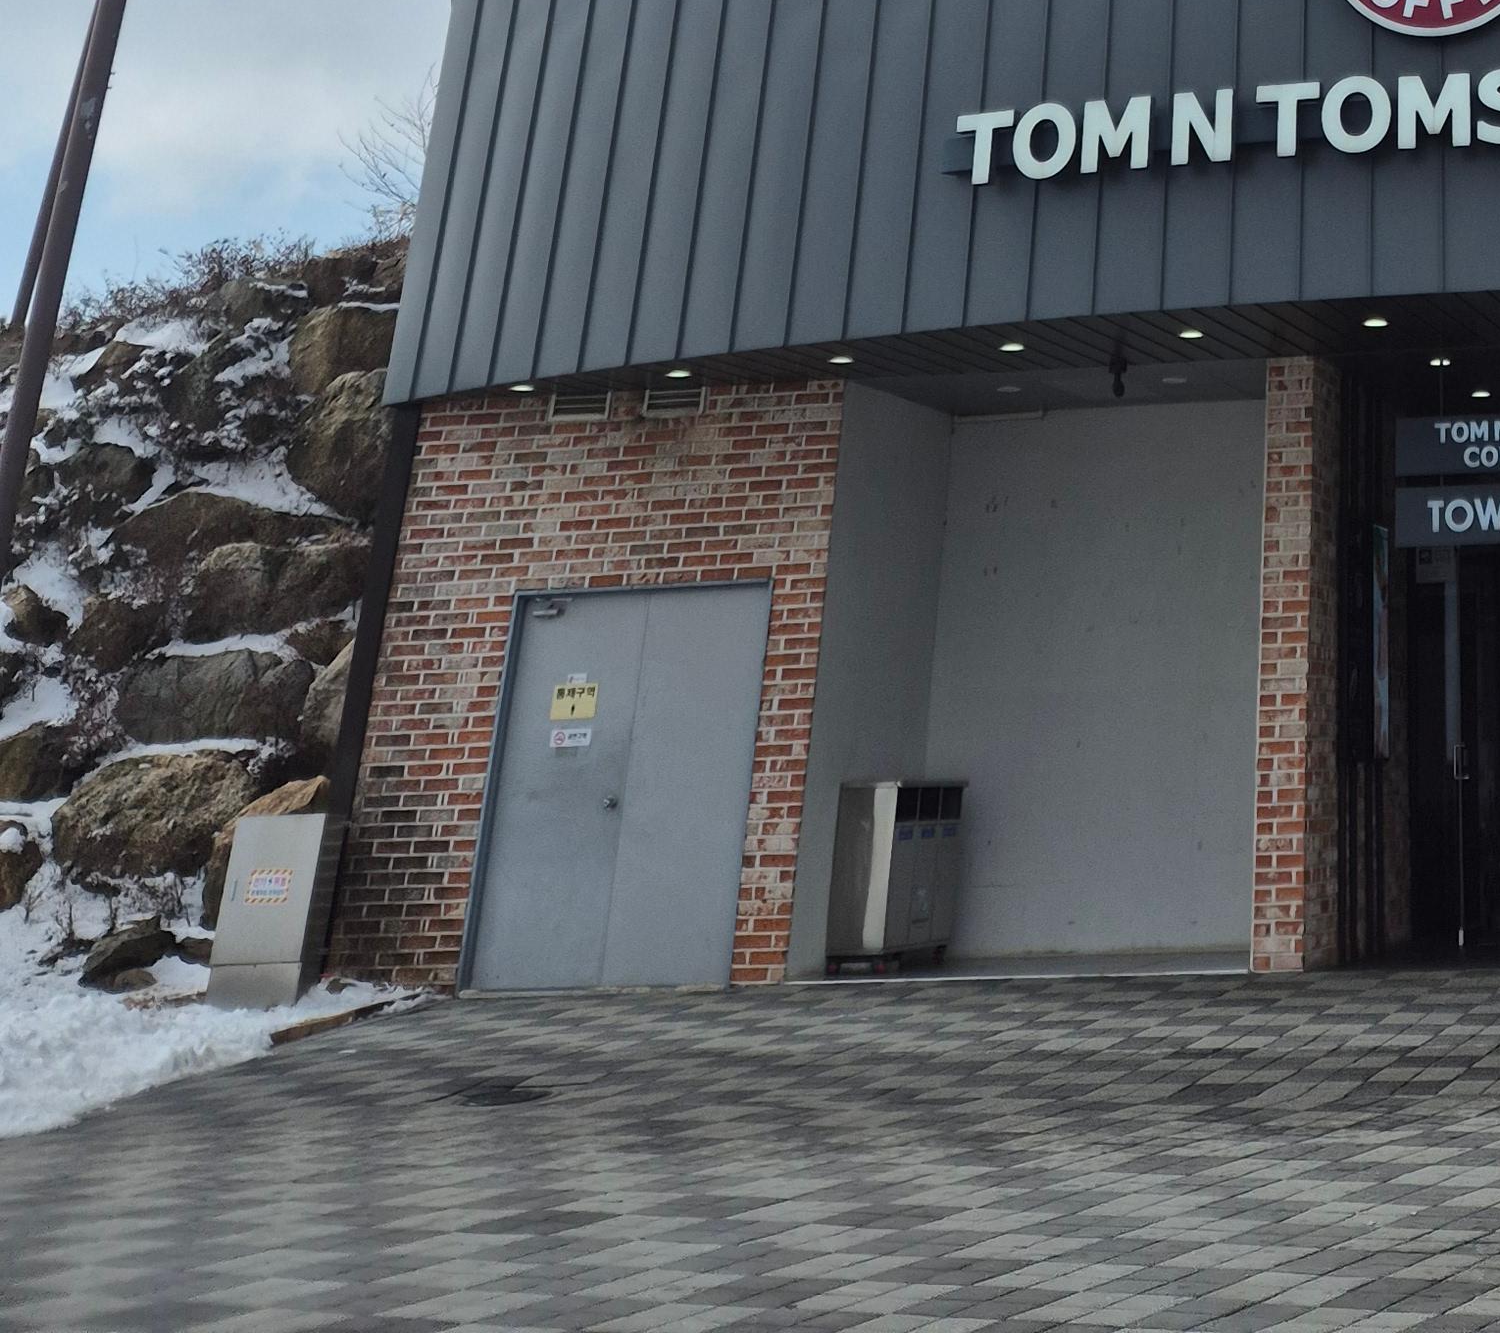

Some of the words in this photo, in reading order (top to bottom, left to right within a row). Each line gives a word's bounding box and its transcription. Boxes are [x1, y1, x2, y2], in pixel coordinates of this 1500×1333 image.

[956, 95, 1152, 185] TOM
[1170, 88, 1234, 166] N
[1434, 420, 1489, 444] TOM
